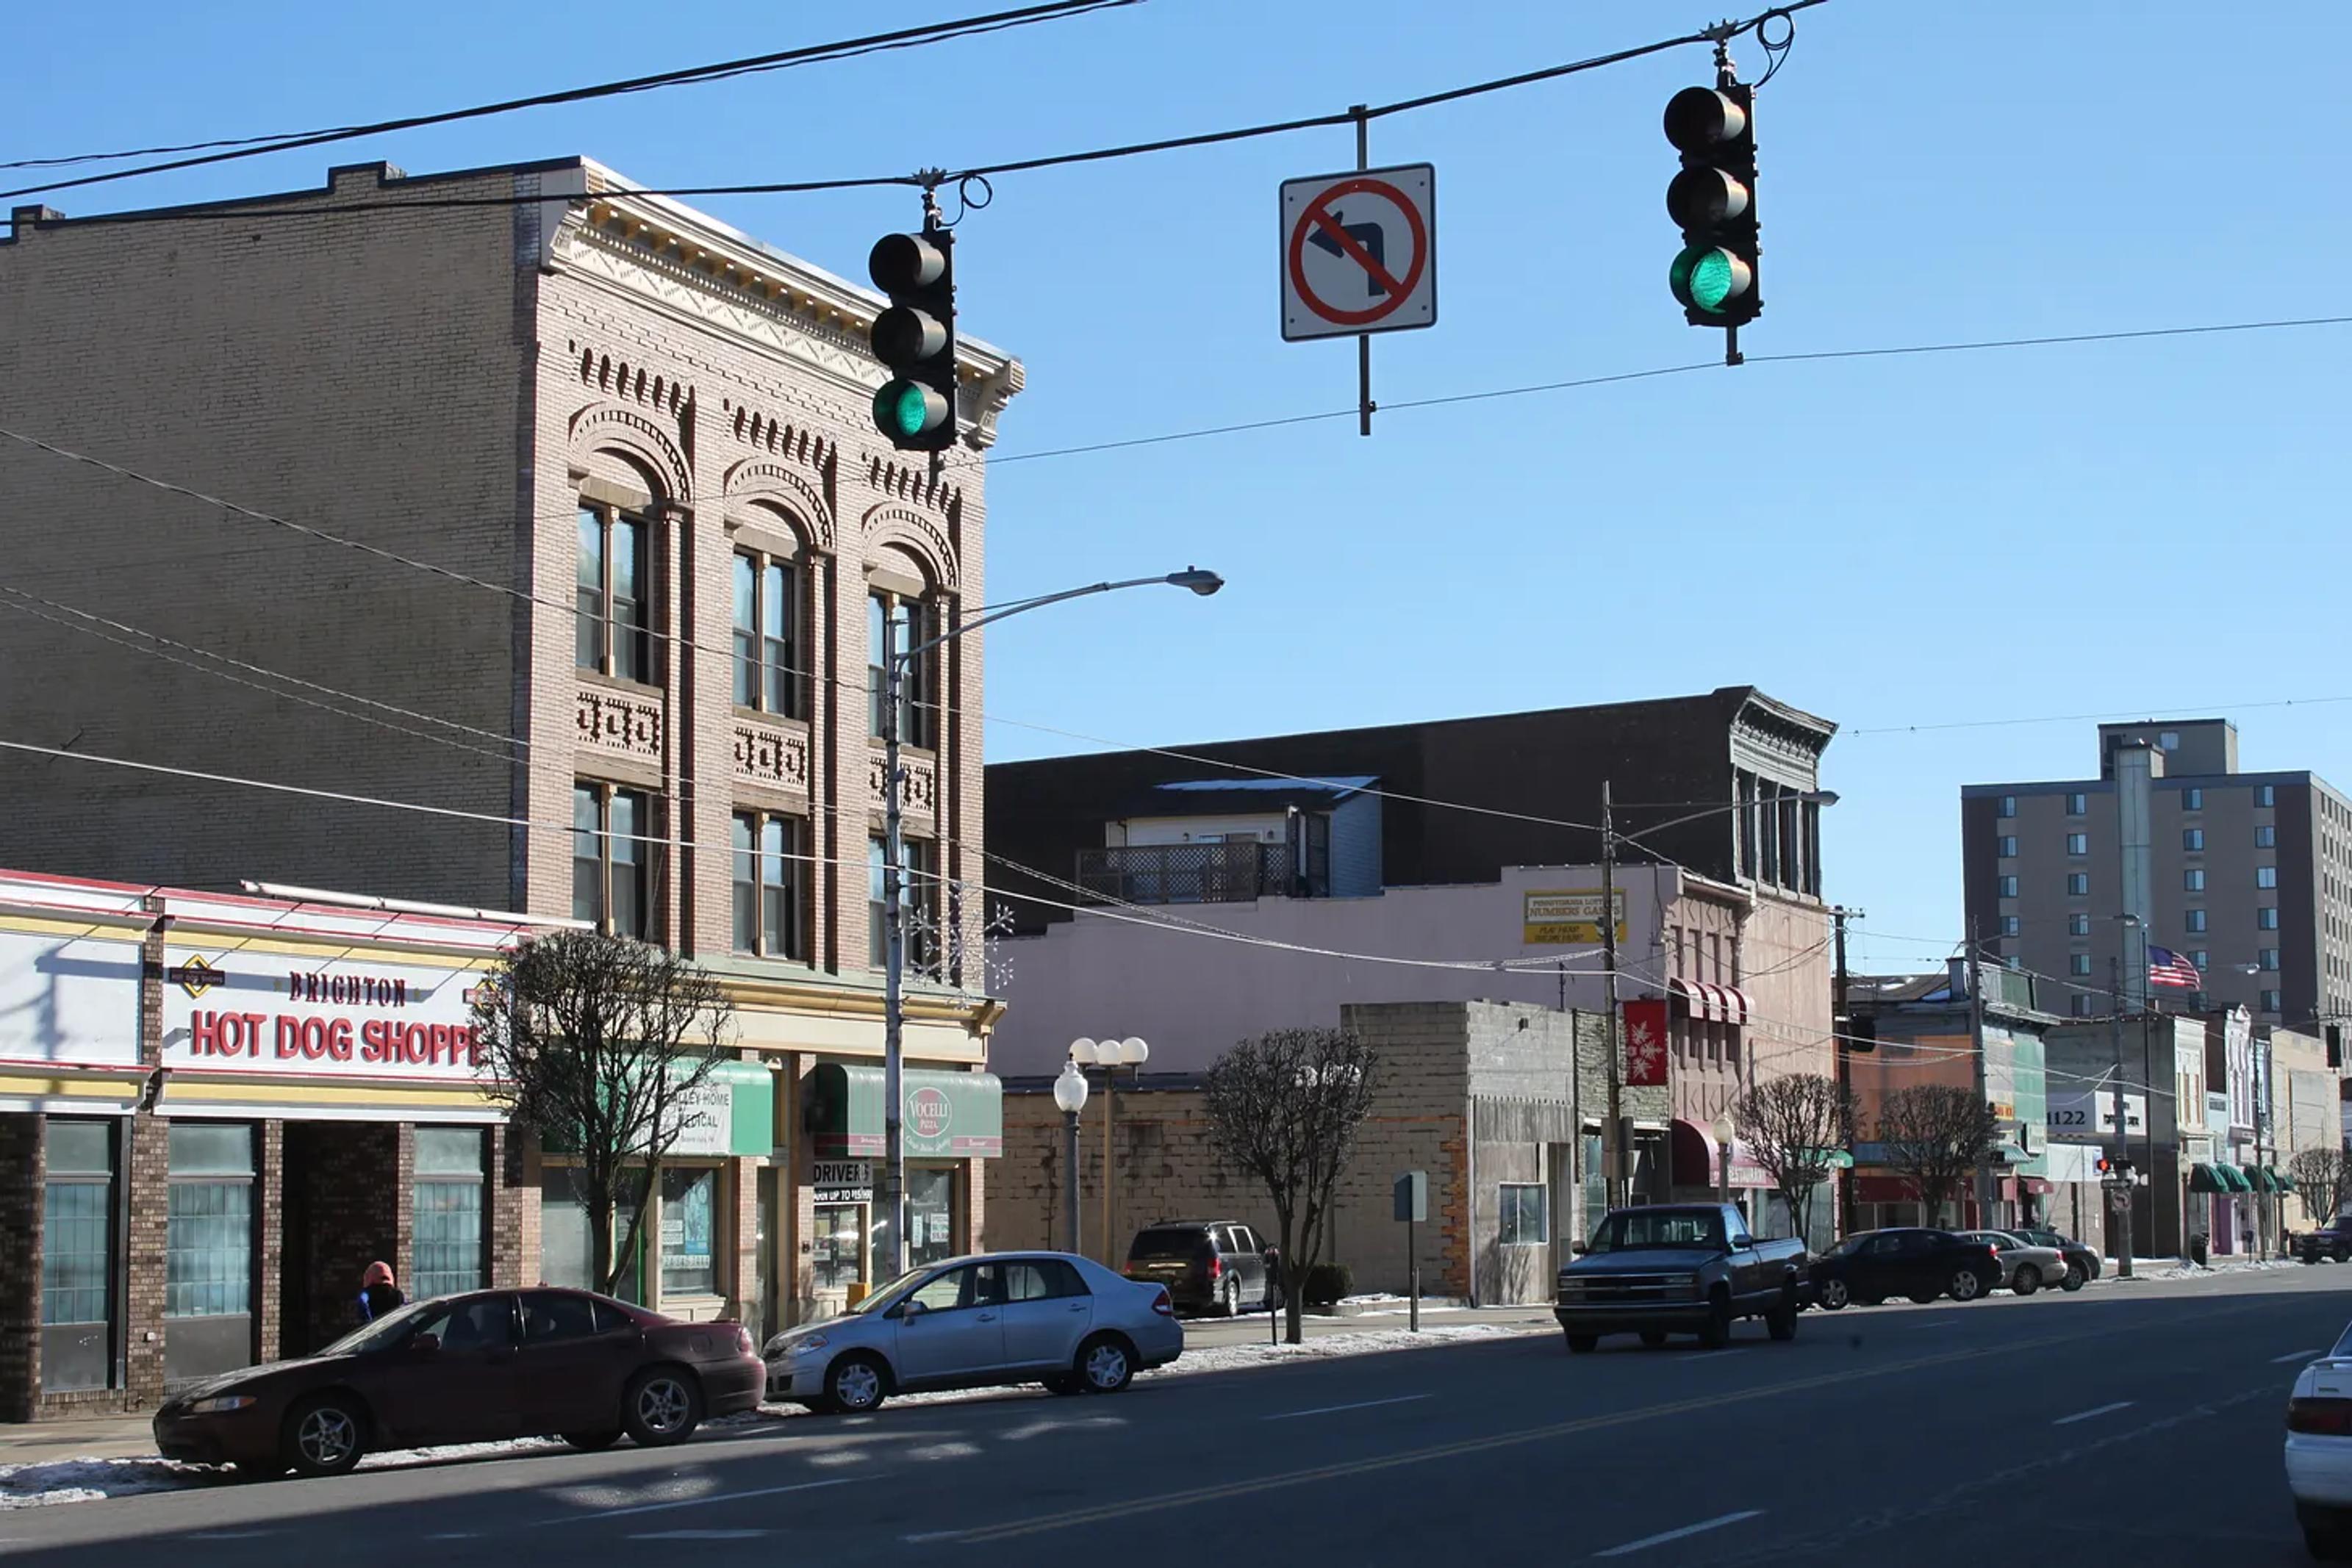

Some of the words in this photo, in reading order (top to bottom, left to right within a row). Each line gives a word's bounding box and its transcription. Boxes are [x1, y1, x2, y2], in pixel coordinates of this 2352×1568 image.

[1530, 907, 1580, 917] NUMBERS
[289, 971, 406, 1007] BRIGHTON
[190, 1010, 268, 1058] HOT
[275, 1014, 354, 1061] DOG
[703, 1093, 729, 1106] HOME
[909, 1099, 948, 1118] VOCELLI
[919, 1118, 939, 1129] PIZZA
[2047, 1110, 2086, 1126] 1122
[814, 1164, 869, 1182] DRIVERS
[829, 1190, 839, 1201] UP
[841, 1190, 850, 1201] TO
